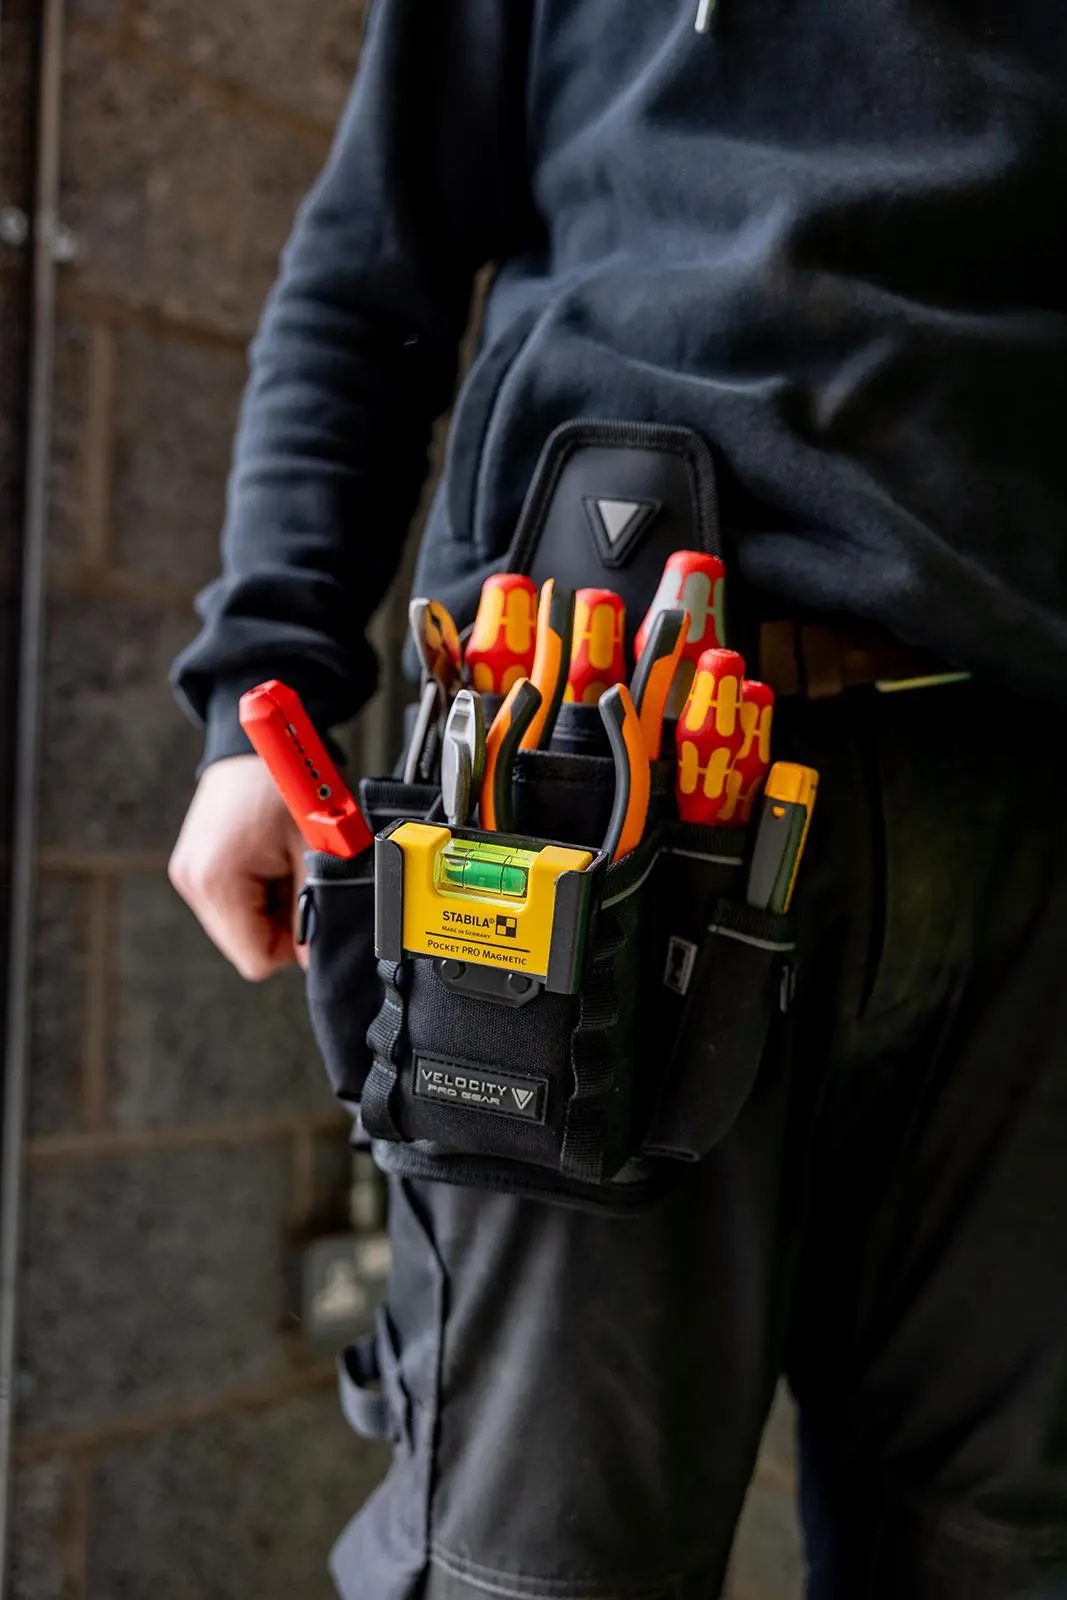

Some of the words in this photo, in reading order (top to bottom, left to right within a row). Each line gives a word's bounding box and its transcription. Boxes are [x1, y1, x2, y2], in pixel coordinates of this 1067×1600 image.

[427, 939, 460, 953] POCKET
[461, 945, 480, 957] PRO
[482, 949, 527, 966] MAGNETIC
[421, 1069, 507, 1096] VELOCITY
[427, 1083, 457, 1097] PRO
[460, 1091, 501, 1106] GEAR
